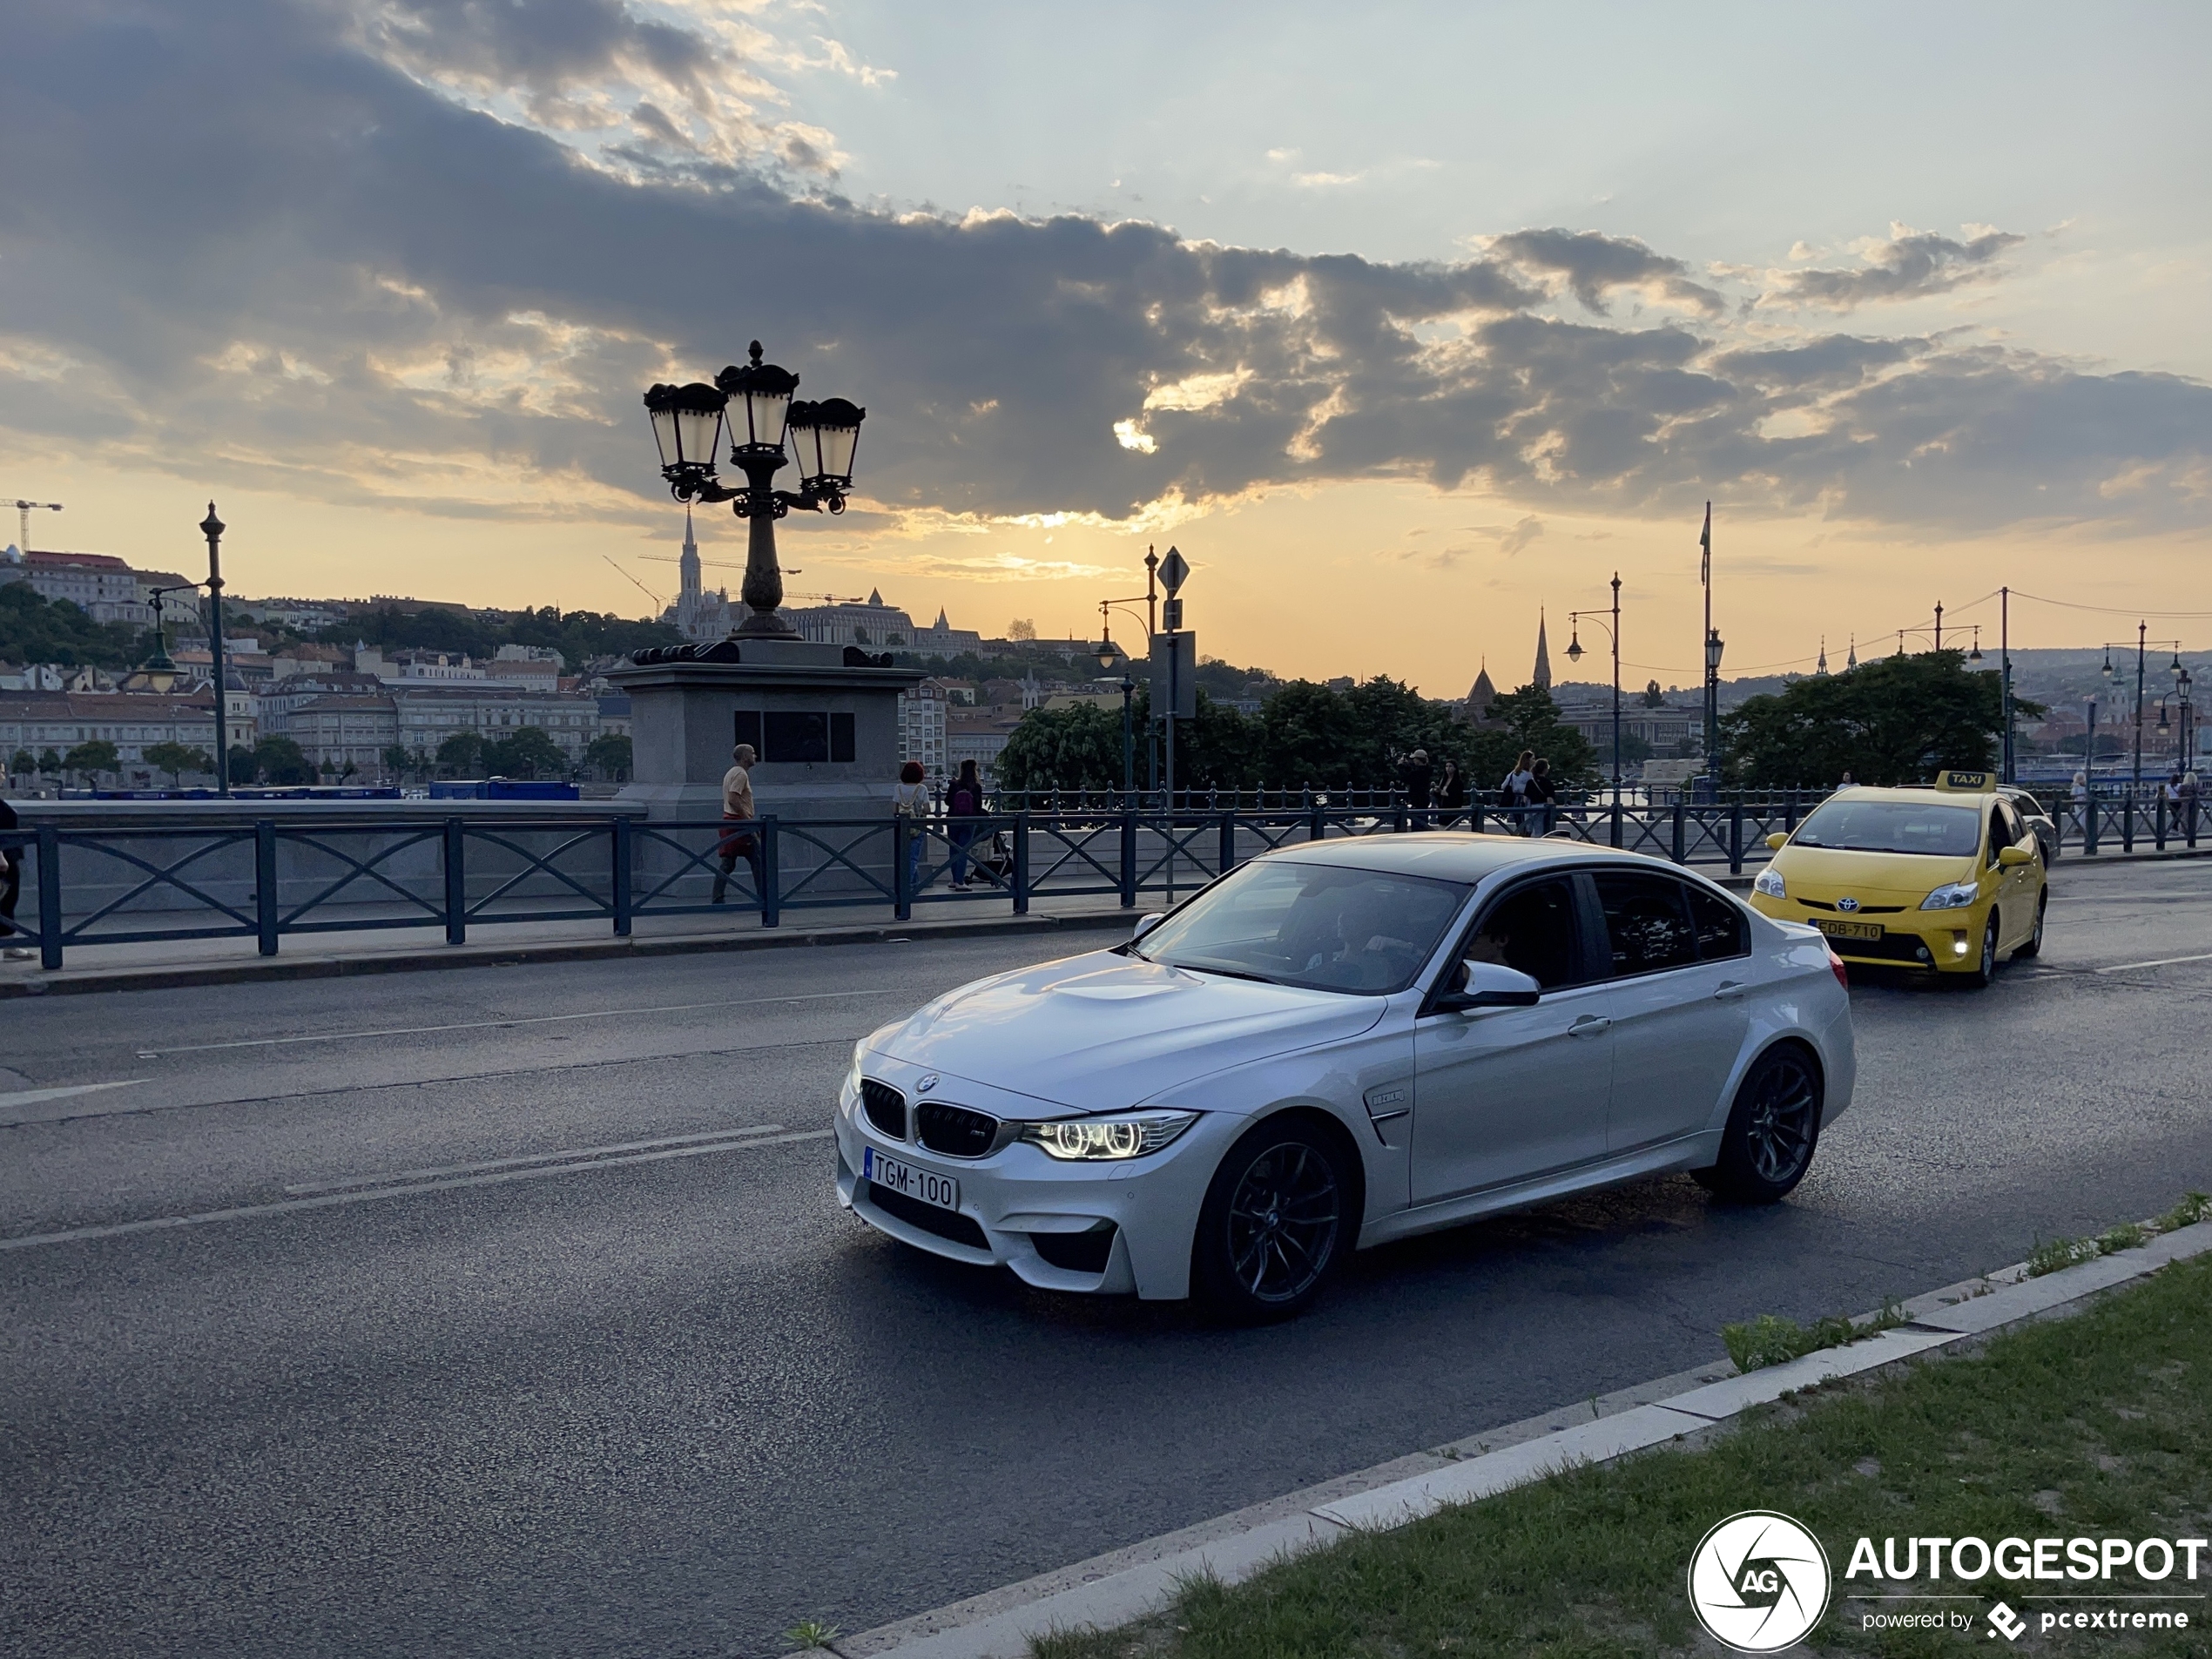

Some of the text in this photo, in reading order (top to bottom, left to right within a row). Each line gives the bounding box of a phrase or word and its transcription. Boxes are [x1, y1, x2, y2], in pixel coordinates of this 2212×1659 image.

[1952, 774, 1982, 784] TAXI
[1819, 922, 1878, 938] EDB-710
[875, 1155, 951, 1205] TGM-100
